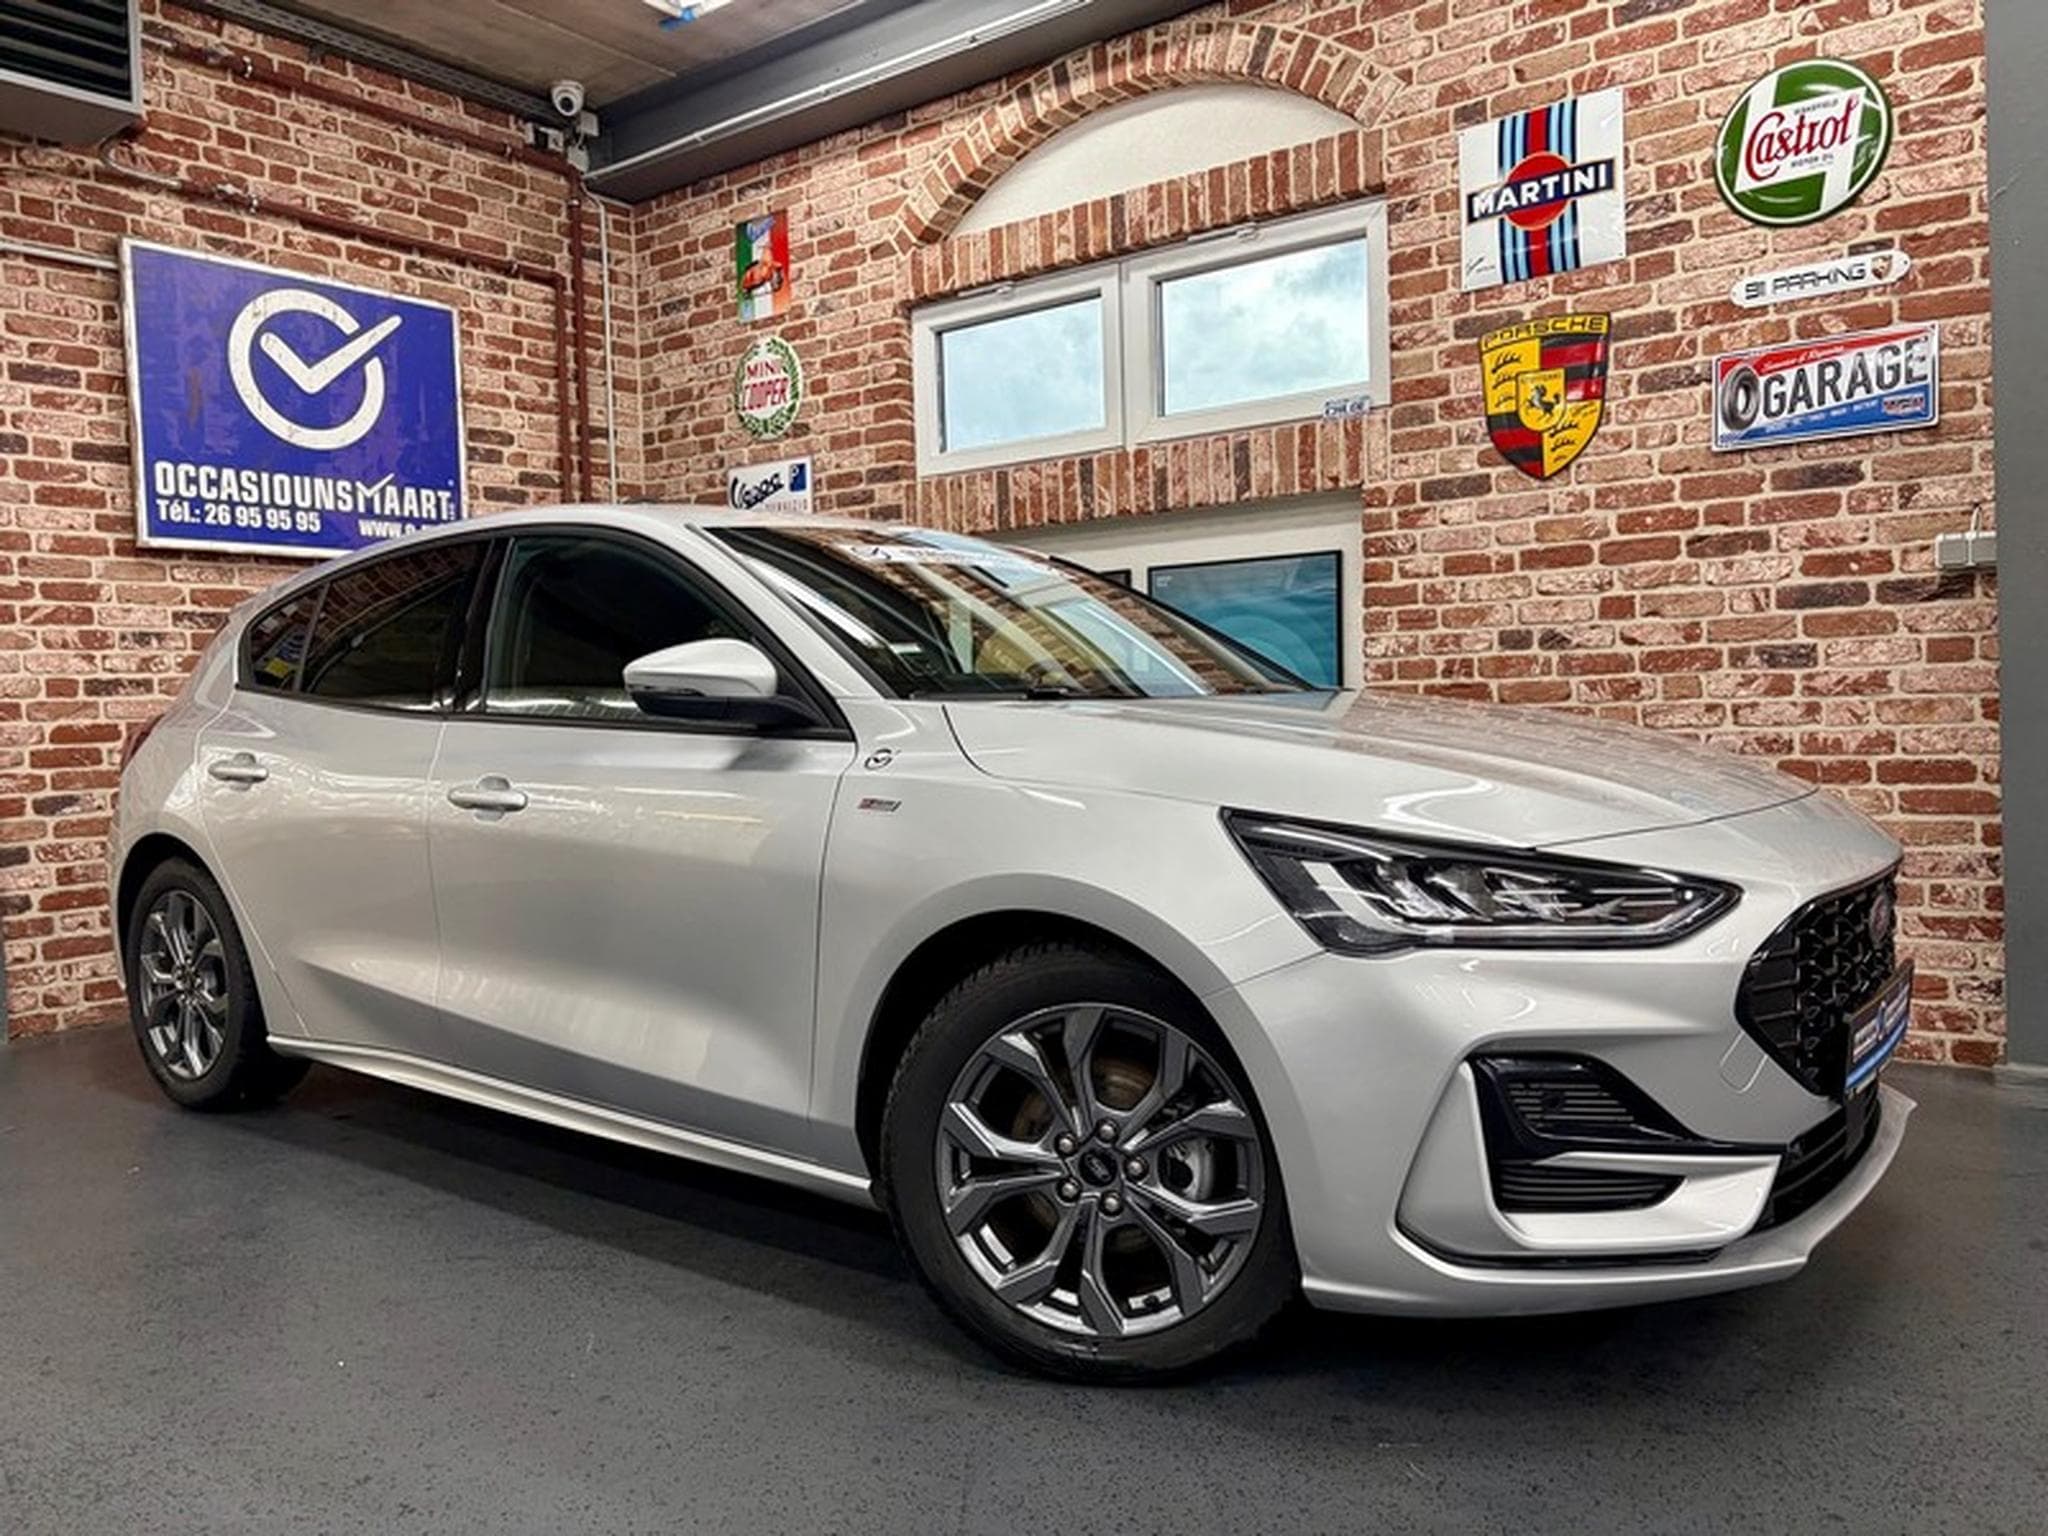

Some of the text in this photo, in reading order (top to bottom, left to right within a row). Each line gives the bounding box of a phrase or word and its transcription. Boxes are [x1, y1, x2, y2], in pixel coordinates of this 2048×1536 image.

[1746, 93, 1859, 182] Castrol
[1473, 163, 1607, 219] MARTINI
[1772, 263, 1866, 294] PARKING
[1484, 316, 1604, 349] PORSCHE
[1763, 335, 1929, 419] GARAGE
[154, 460, 452, 520] OCCASIOUNSMAART
[731, 472, 784, 510] Vespa
[204, 502, 231, 525] 26
[235, 505, 262, 528] 95
[266, 507, 292, 531] 95
[296, 510, 321, 533] 95
